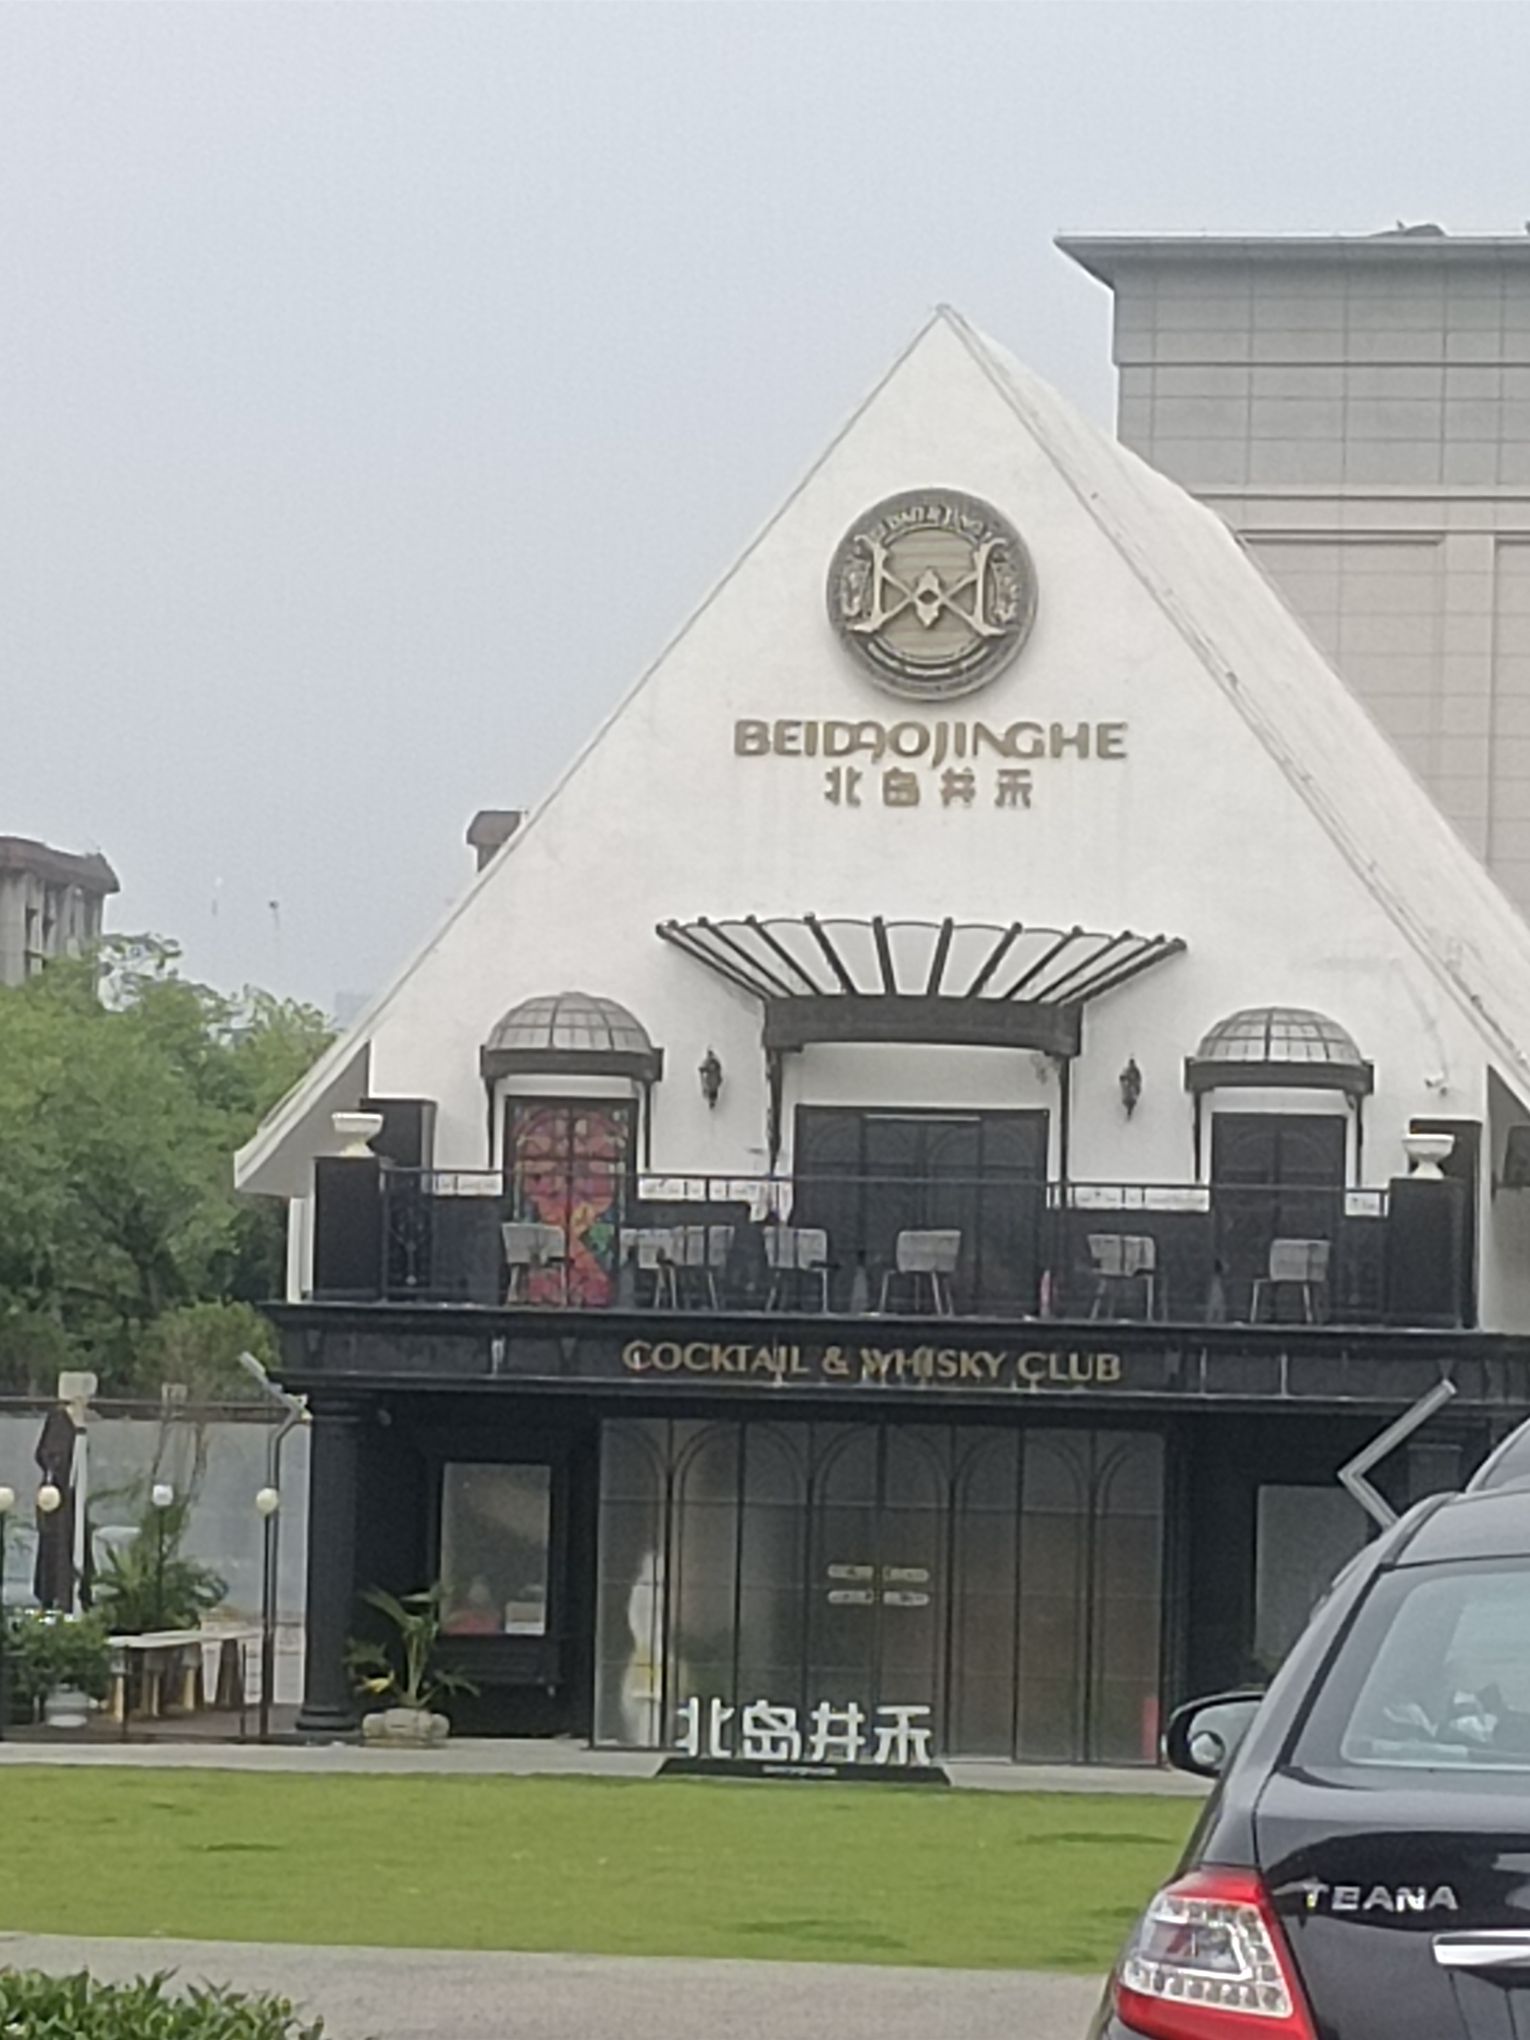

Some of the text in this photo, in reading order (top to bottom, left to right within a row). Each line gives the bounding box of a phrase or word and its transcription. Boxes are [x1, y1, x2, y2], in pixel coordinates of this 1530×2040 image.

[734, 719, 1128, 767] BEIDAOJINGHE
[622, 1340, 1121, 1382] COCKTAIL & WHISKY CLUB
[675, 1697, 931, 1765] 北岛井禾
[1302, 1882, 1458, 1911] TEANA
